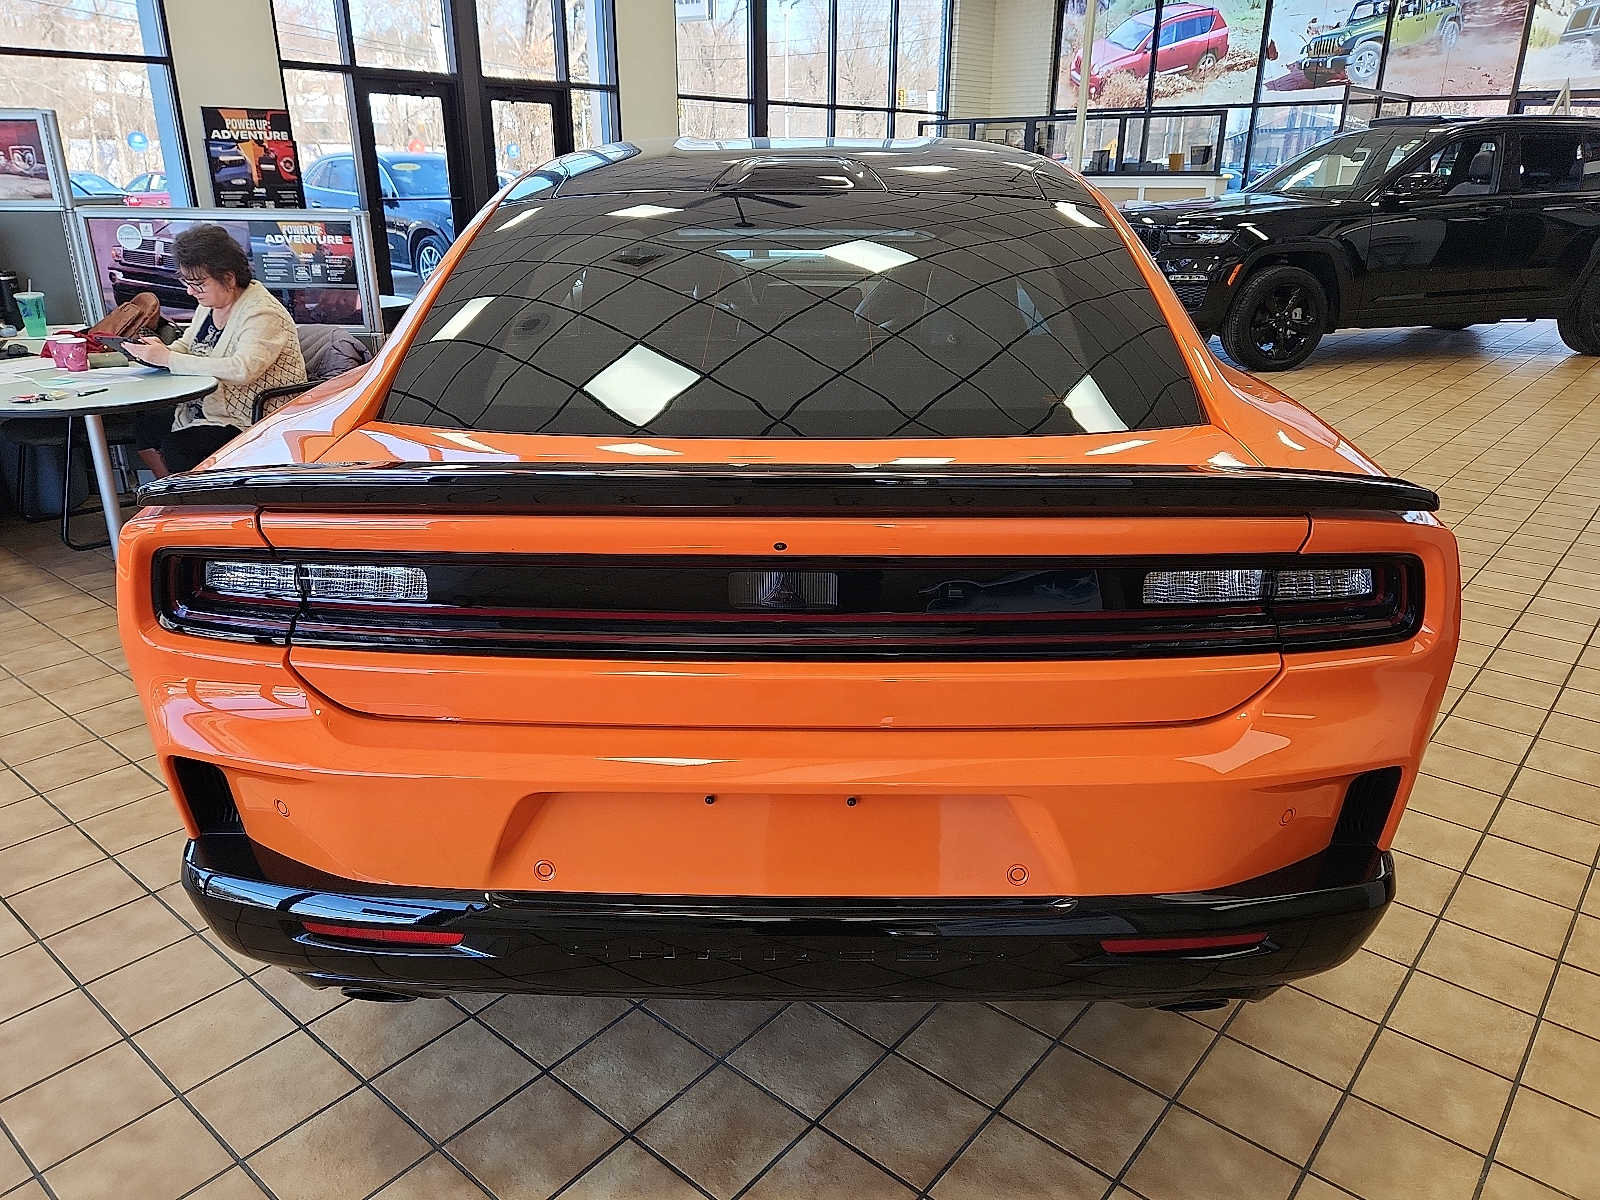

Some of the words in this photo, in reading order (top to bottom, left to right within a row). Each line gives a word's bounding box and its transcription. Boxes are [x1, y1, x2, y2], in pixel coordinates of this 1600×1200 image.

[225, 118, 255, 130] POWER
[256, 119, 272, 130] UP:
[211, 129, 289, 141] ADVENTURE
[281, 225, 309, 235] POWER
[265, 234, 344, 245] ADVENTURE
